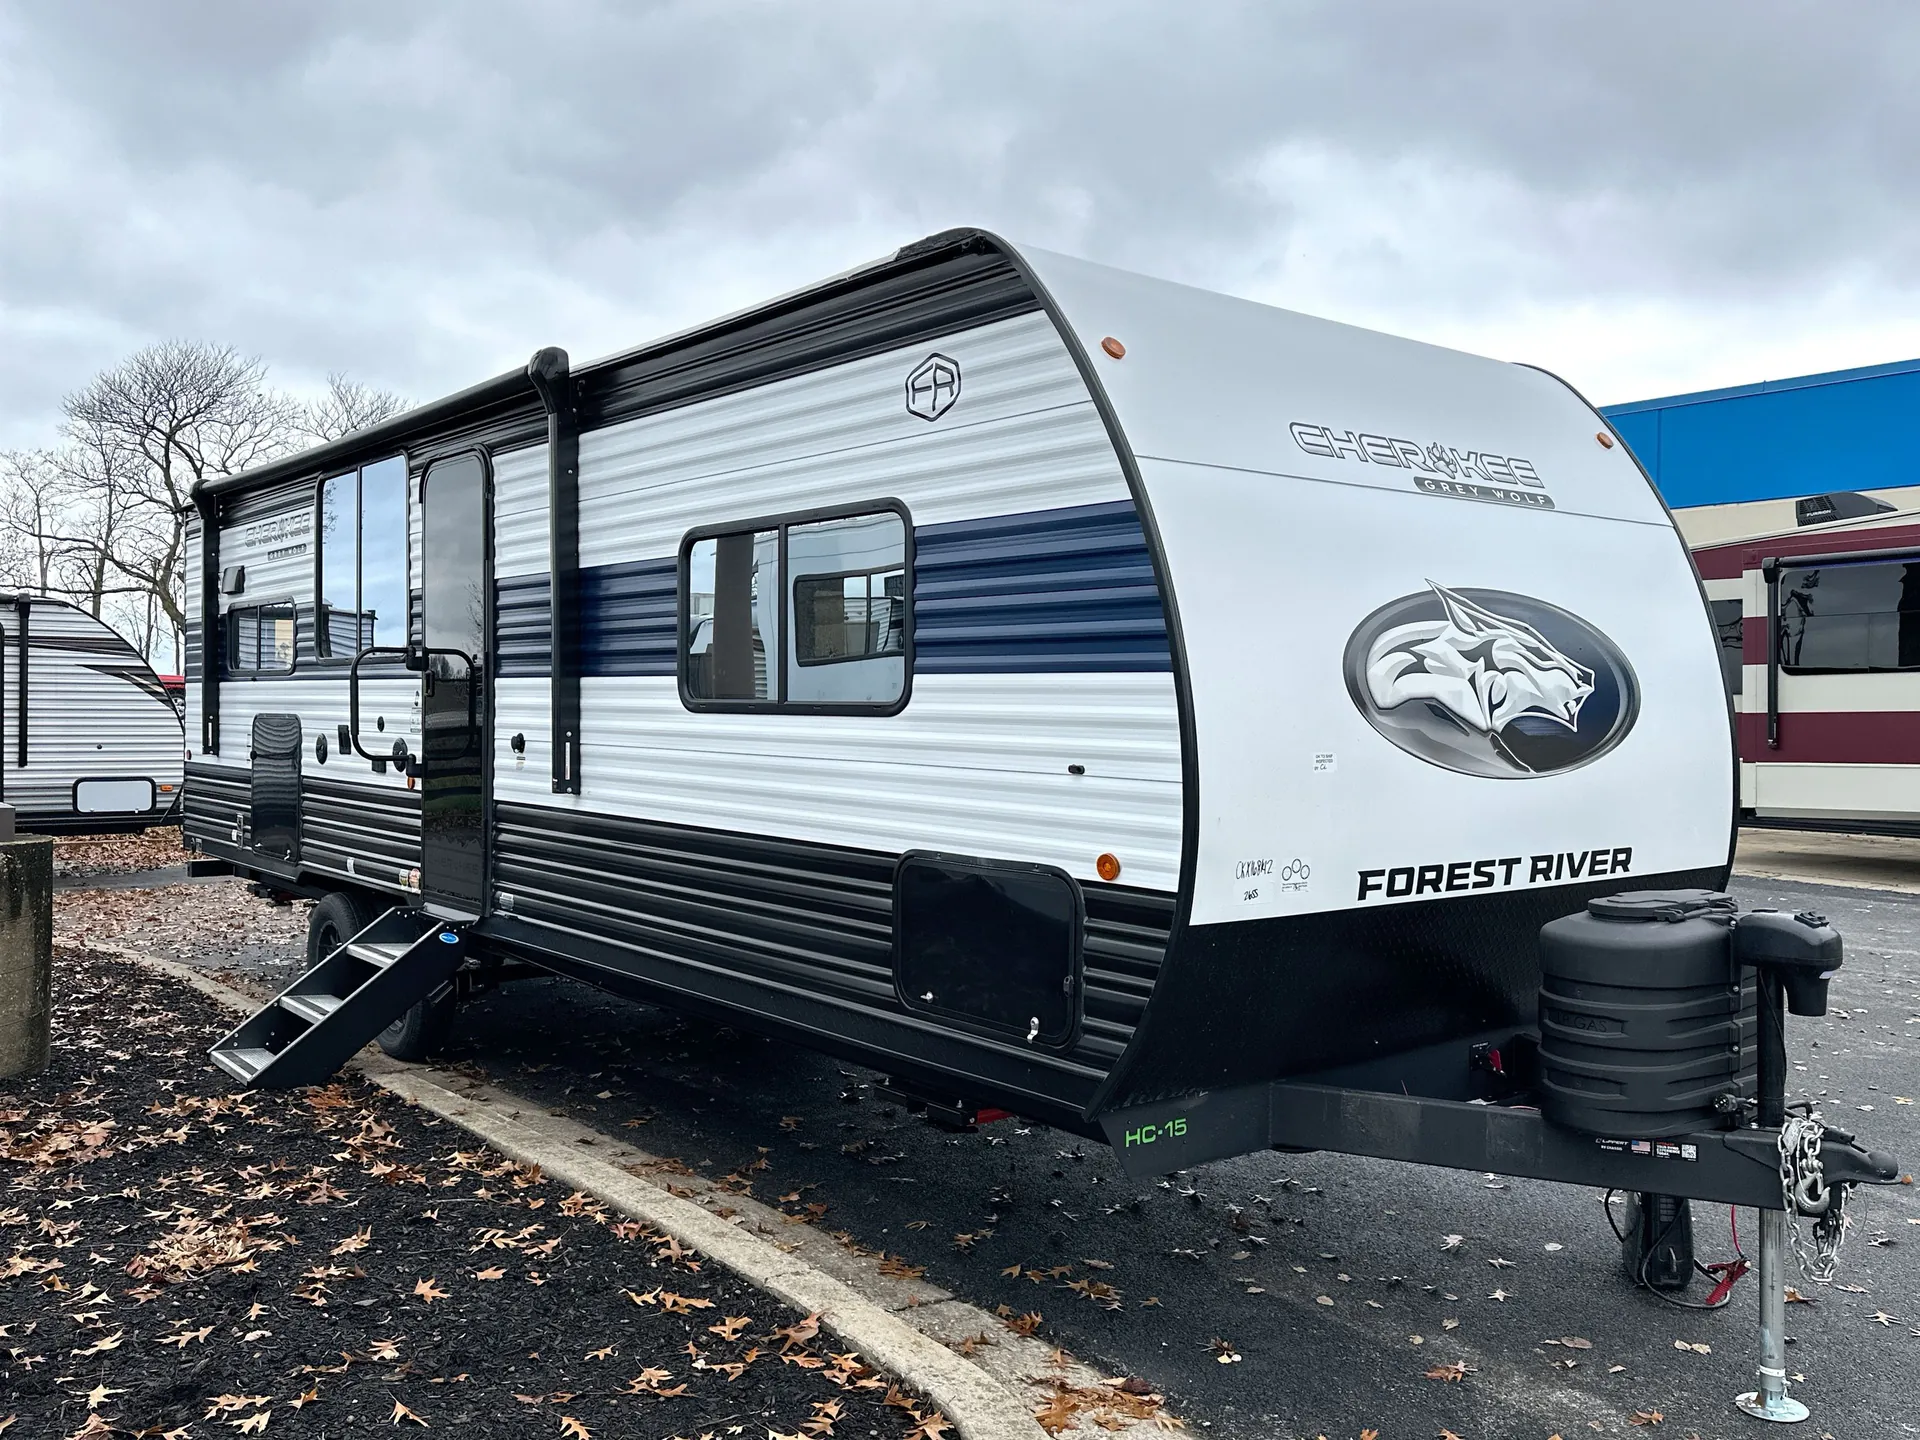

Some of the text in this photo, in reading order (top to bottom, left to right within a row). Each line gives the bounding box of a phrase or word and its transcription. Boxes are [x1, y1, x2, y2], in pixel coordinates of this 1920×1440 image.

[1289, 421, 1545, 489] CHEROKEE
[1424, 480, 1546, 506] GREY WOLF
[1357, 847, 1633, 901] FOREST RIVER
